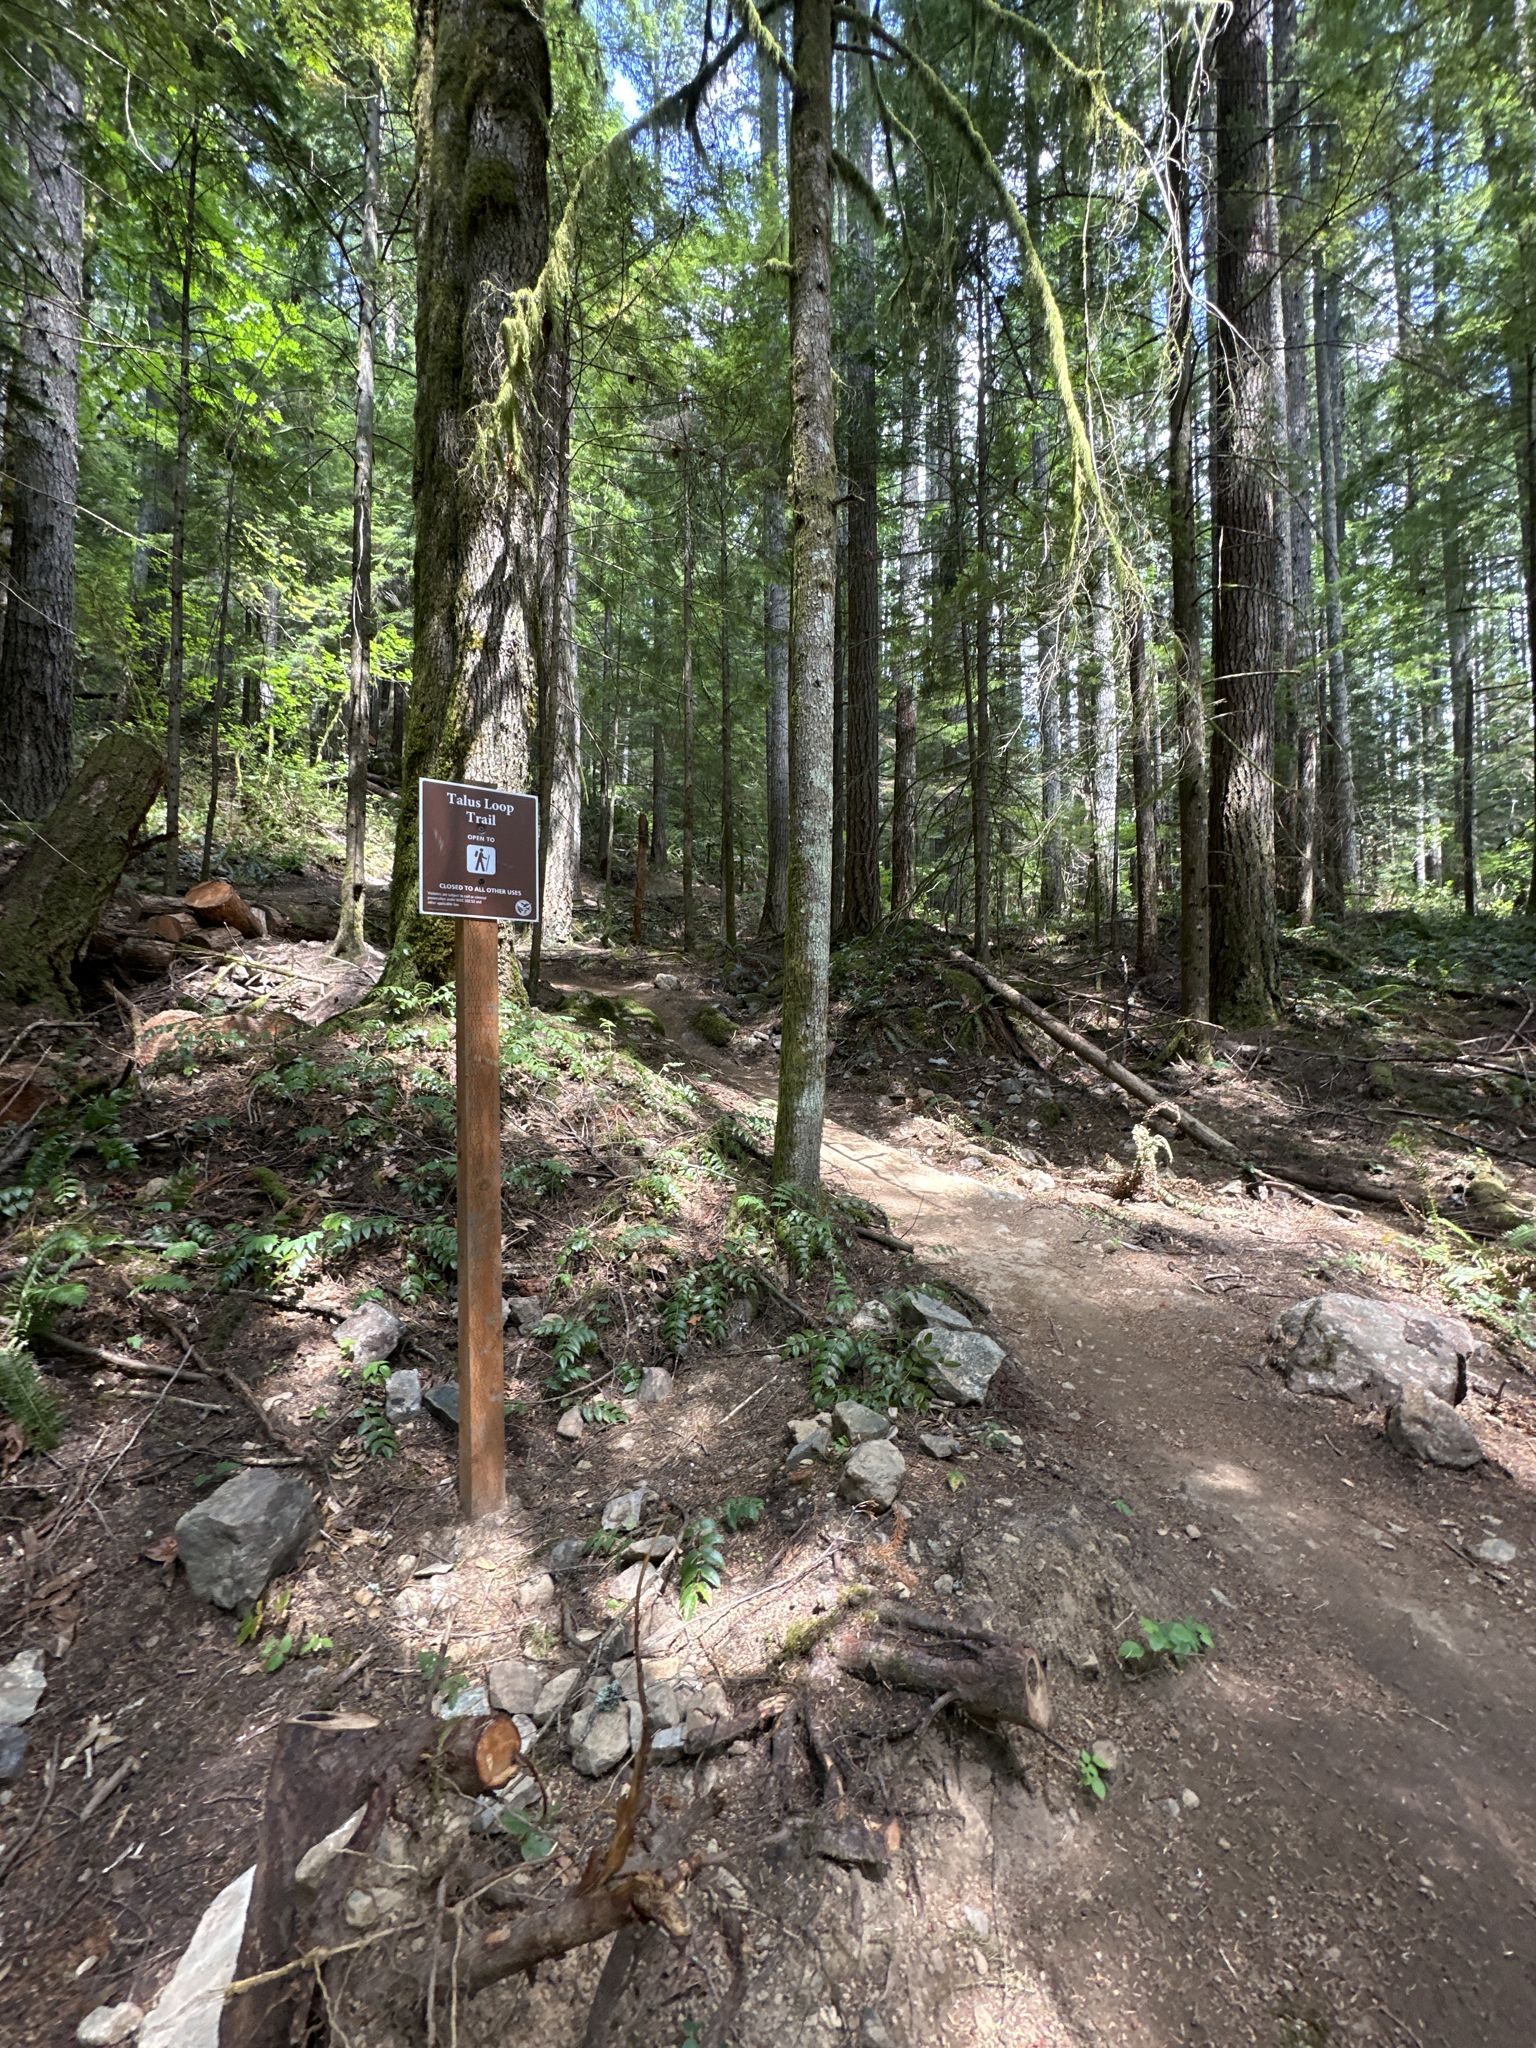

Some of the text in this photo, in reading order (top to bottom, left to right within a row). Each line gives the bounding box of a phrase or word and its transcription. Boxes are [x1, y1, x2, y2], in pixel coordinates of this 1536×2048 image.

[446, 792, 514, 816] Talus Loop
[466, 811, 496, 826] Trail
[467, 834, 485, 842] OPEN
[439, 882, 464, 890] CLOSED
